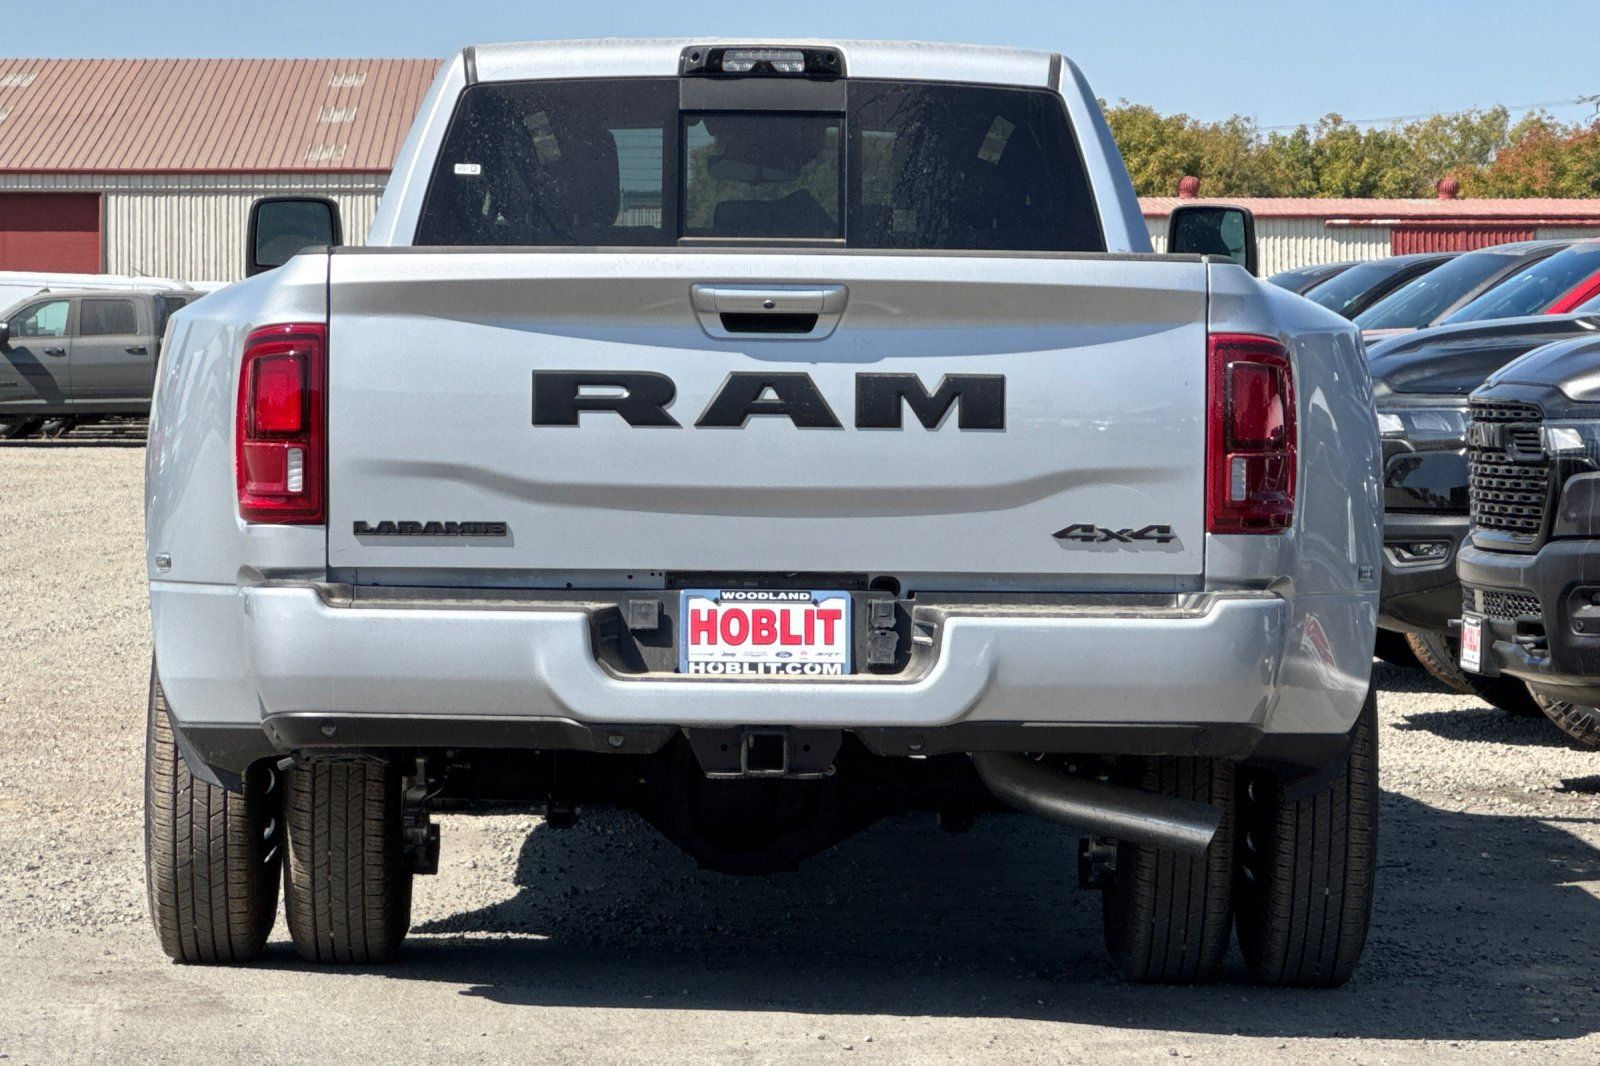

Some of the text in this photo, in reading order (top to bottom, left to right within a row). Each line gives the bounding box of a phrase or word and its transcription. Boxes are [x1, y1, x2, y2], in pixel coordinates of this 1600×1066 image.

[532, 369, 1006, 432] RAM
[722, 592, 810, 600] WOODLAND
[690, 608, 842, 645] HOBLIT
[688, 661, 842, 675] HOBLIT.COM
